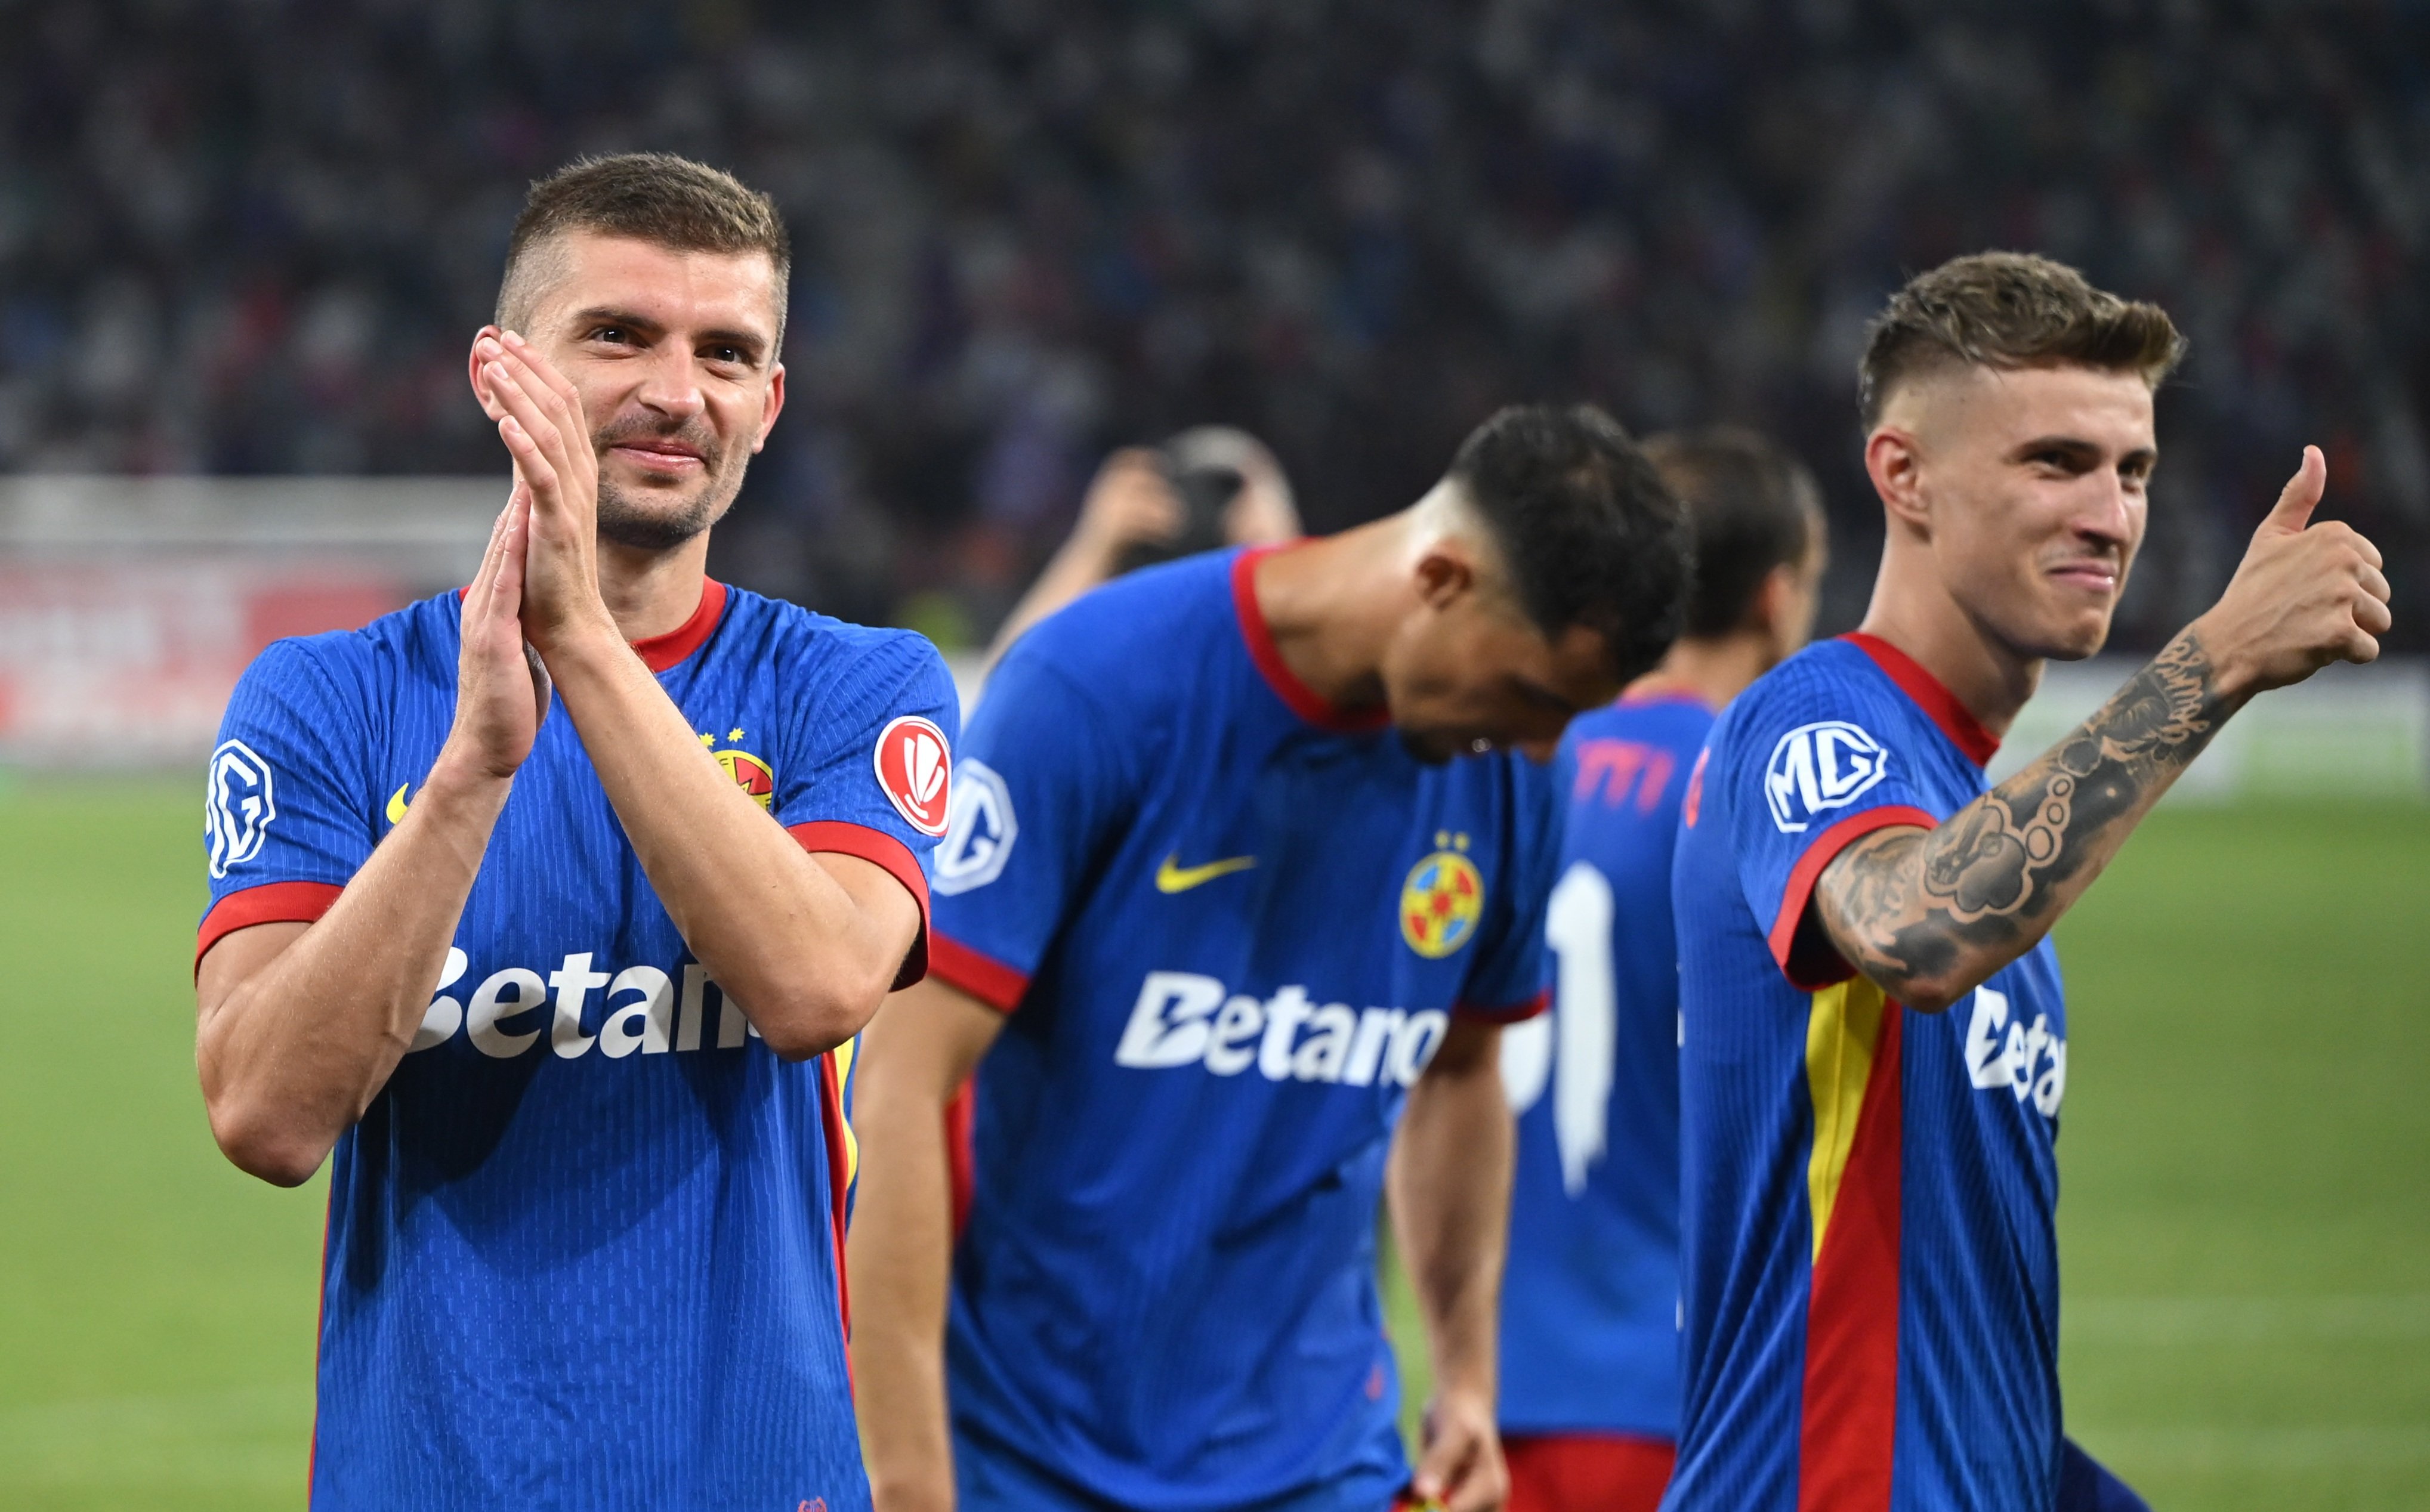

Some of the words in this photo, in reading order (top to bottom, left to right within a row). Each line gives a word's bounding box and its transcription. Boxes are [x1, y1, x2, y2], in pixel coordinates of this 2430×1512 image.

[933, 773, 1005, 879] G
[1769, 726, 1873, 816] MG
[407, 945, 764, 1059] etan
[1114, 970, 1449, 1089] Betano
[1499, 861, 1618, 1199] 1
[1964, 984, 2067, 1118] Beta
